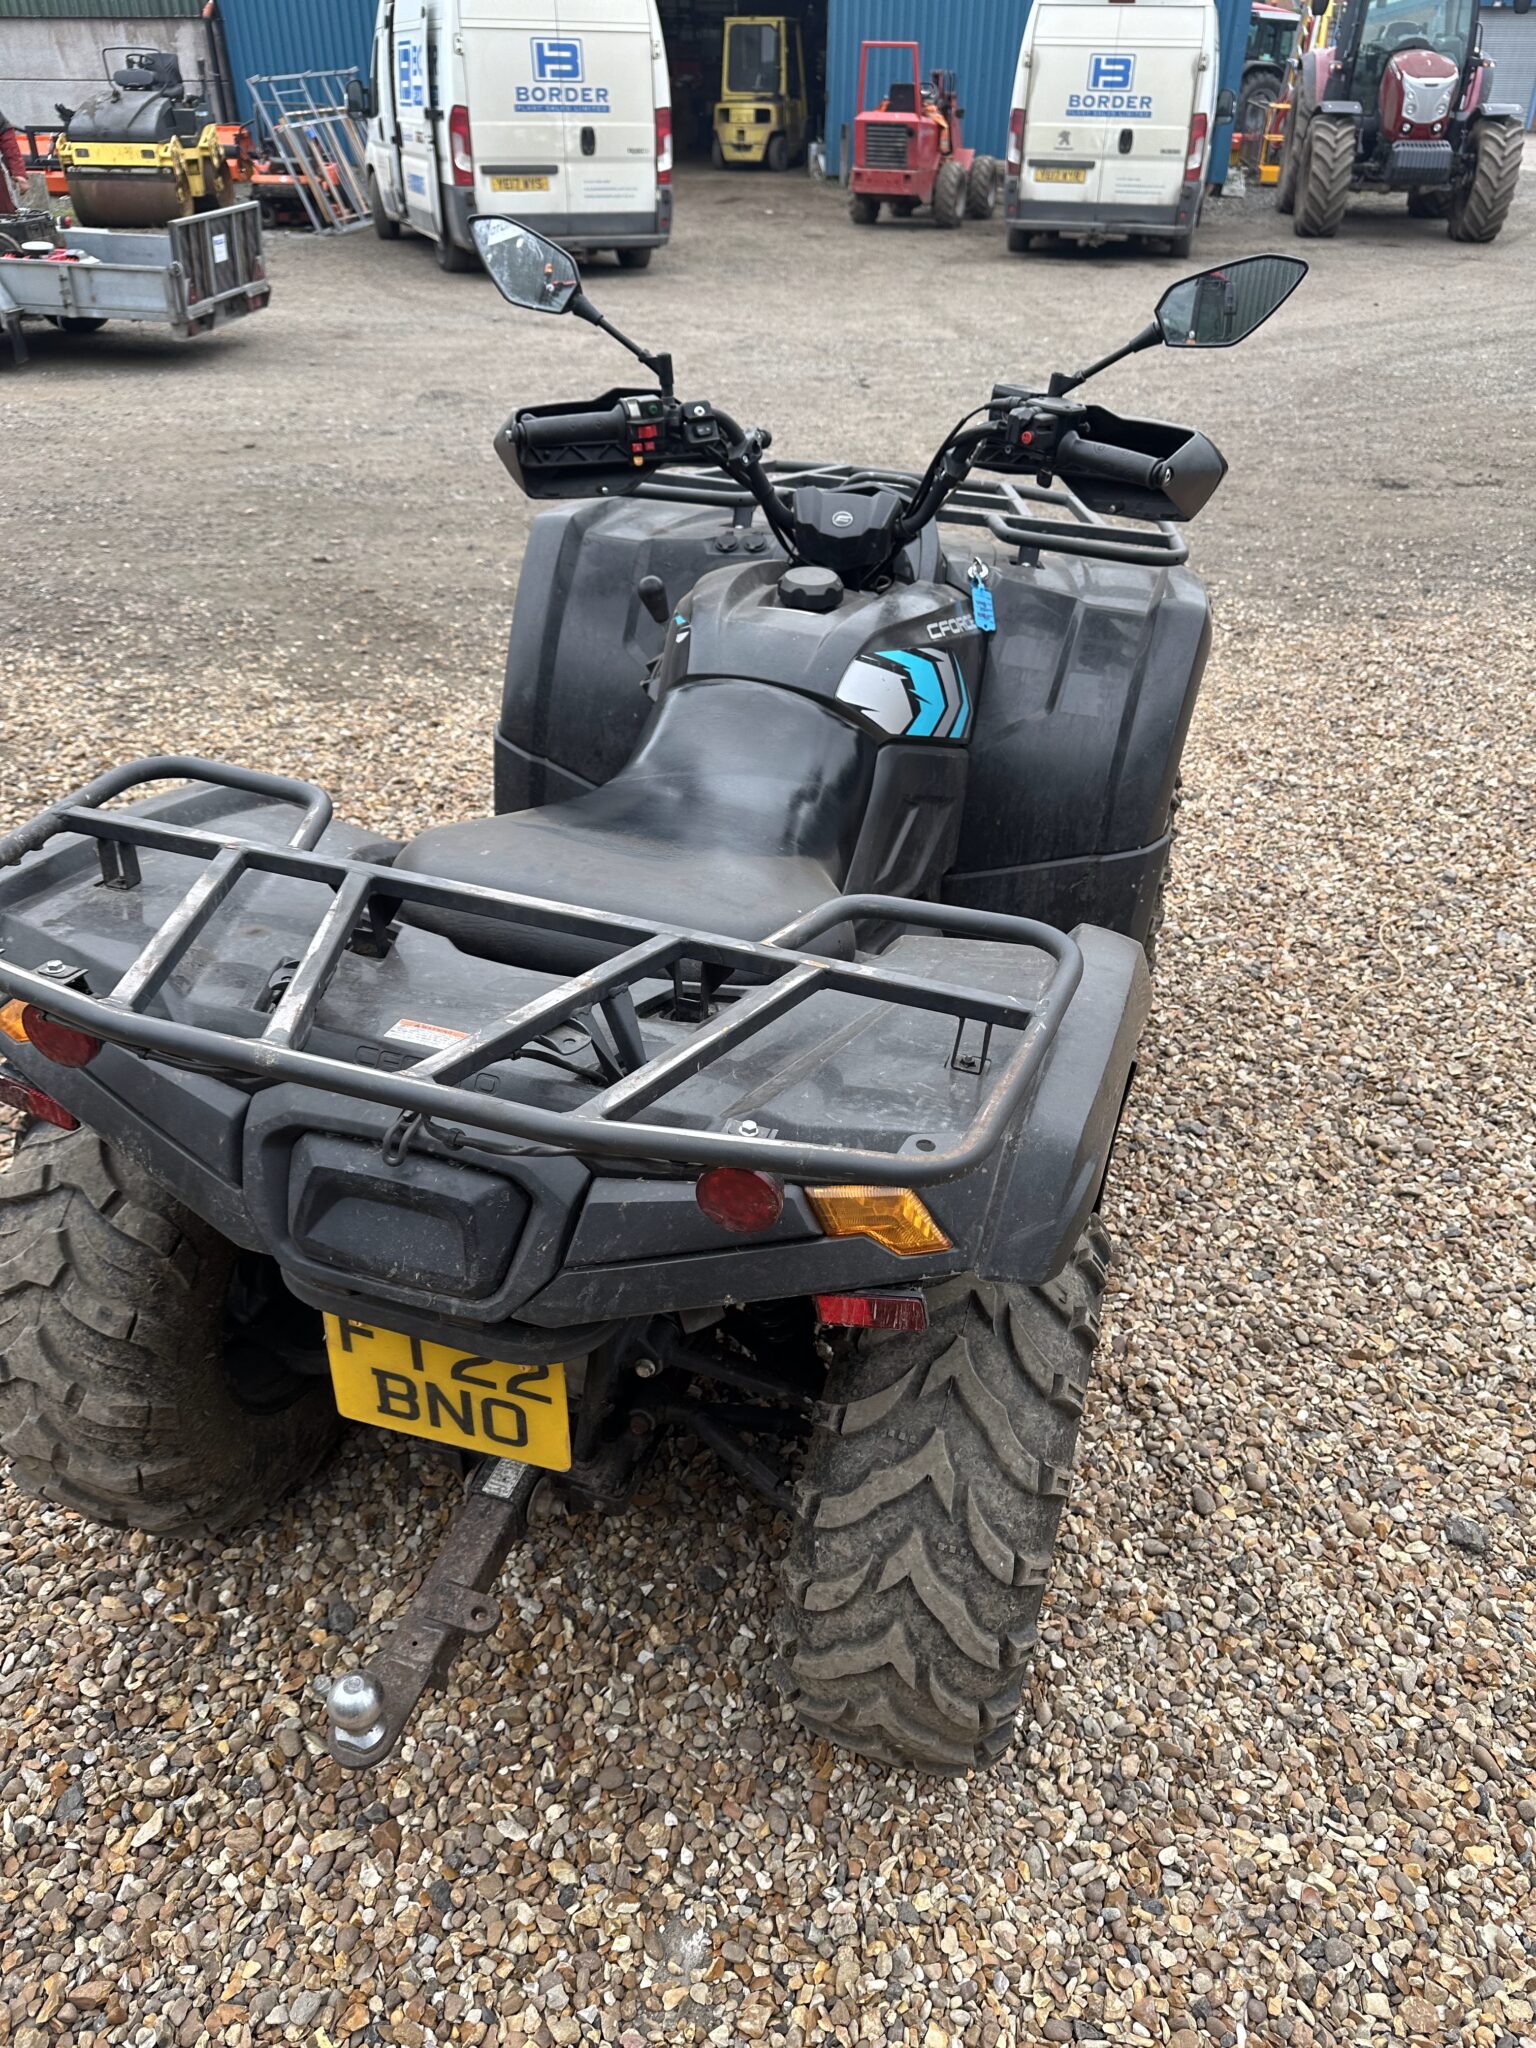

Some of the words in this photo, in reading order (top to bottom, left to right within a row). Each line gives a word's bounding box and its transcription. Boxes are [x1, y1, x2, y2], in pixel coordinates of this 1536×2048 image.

[515, 87, 609, 102] BORDER
[1068, 94, 1152, 109] BORDER
[371, 1367, 528, 1447] BNO
